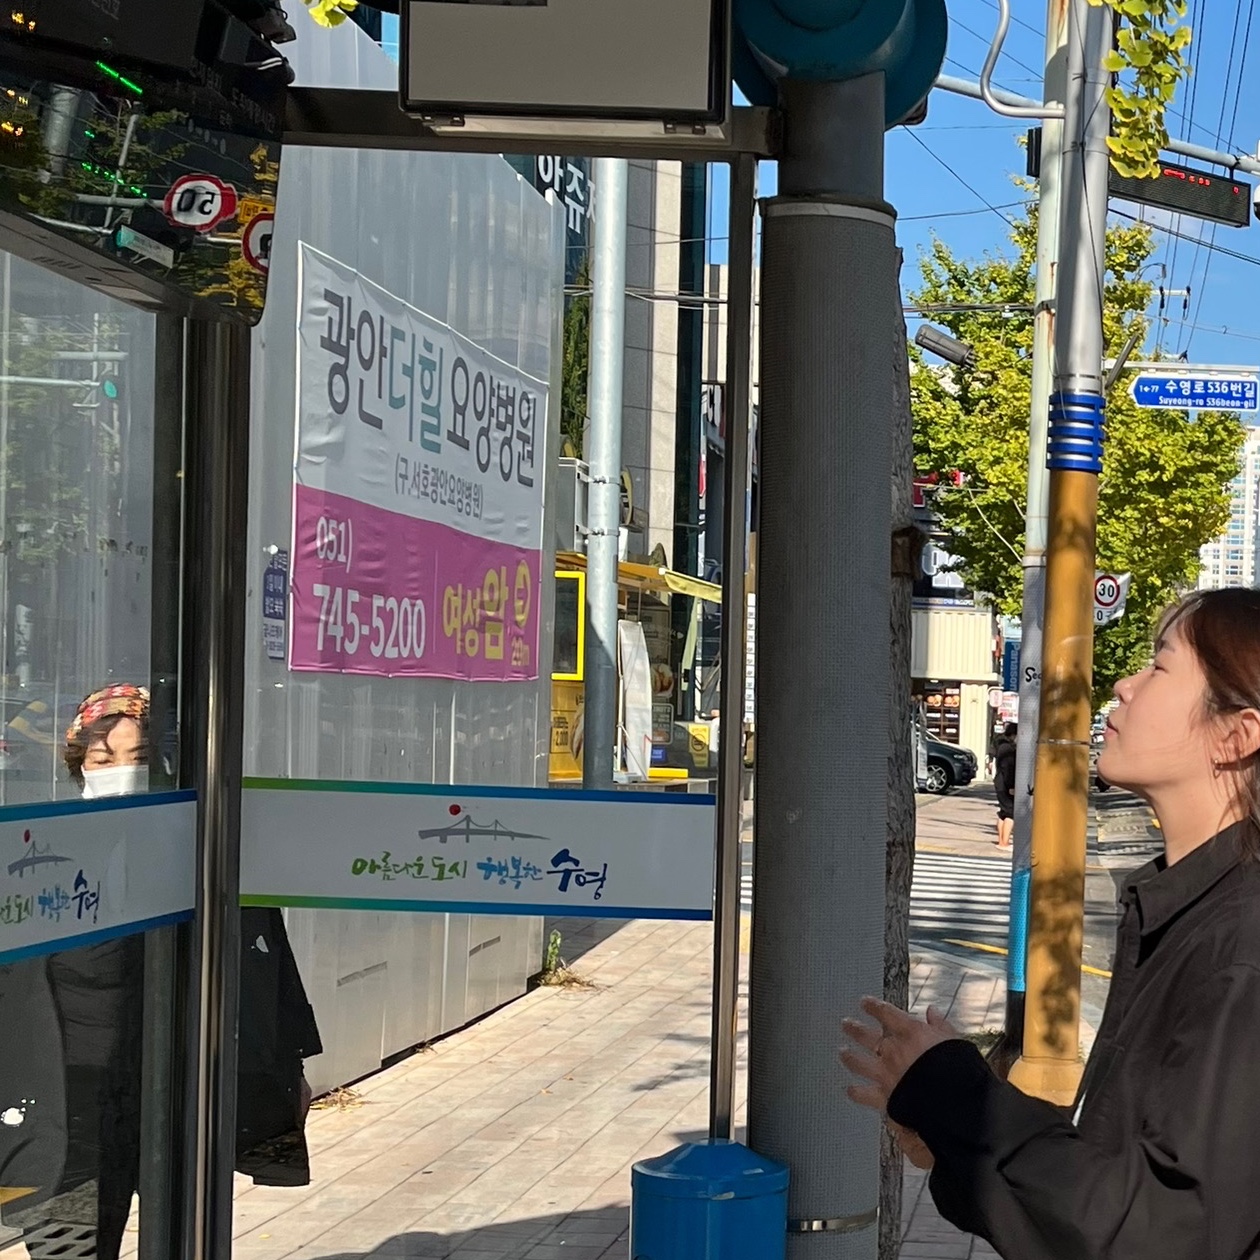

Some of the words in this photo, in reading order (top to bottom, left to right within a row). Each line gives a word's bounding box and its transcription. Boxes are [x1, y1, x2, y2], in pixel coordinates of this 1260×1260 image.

[320, 287, 443, 454] 광안더힐
[446, 356, 536, 488] 요양병원
[316, 516, 353, 574] 051)
[1098, 583, 1115, 598] 30
[313, 583, 426, 659] 745-5200
[432, 856, 468, 881] 도시
[546, 848, 608, 900] 수영
